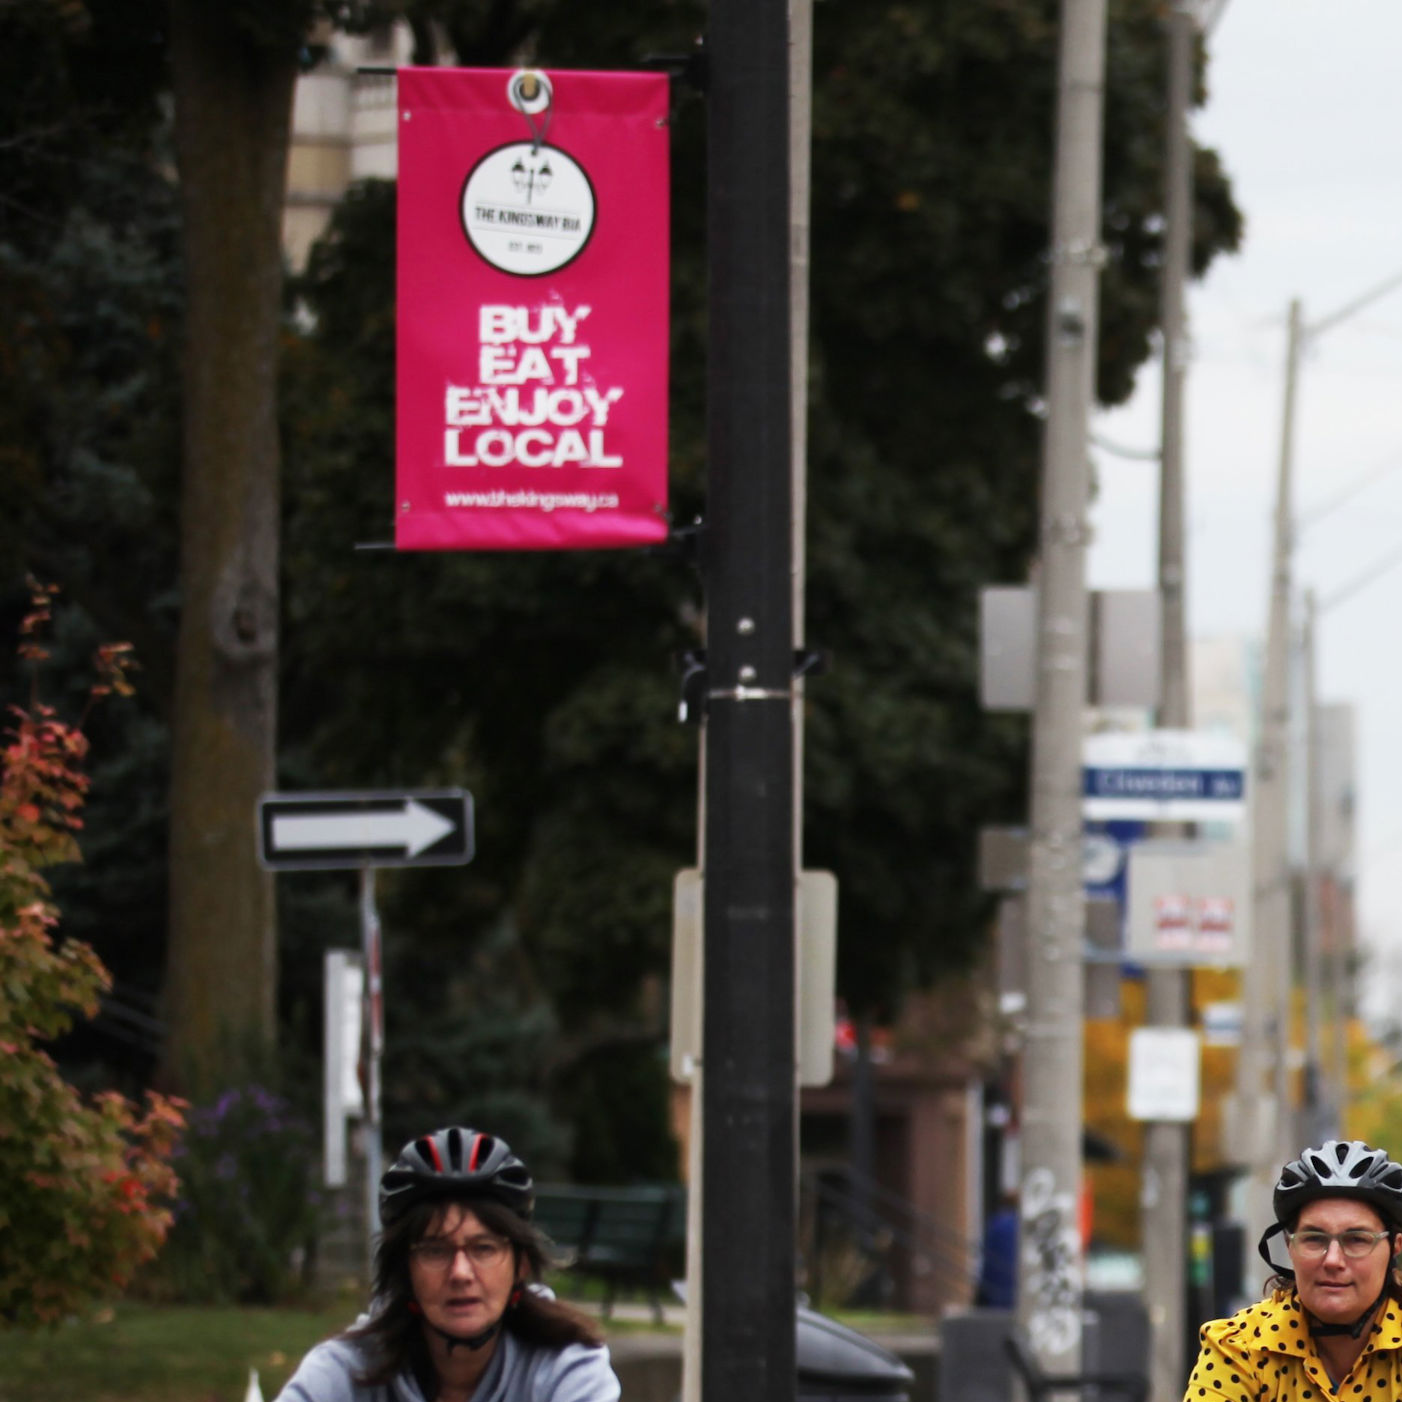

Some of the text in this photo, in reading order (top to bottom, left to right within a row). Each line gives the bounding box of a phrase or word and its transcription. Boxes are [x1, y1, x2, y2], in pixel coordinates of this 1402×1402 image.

[476, 206, 495, 222] THE
[499, 210, 558, 228] KINGSWAY
[479, 304, 592, 344] BUY
[479, 345, 592, 385] EAT
[445, 386, 624, 426] ENJOY
[444, 428, 624, 468] LOCAL
[445, 490, 620, 512] www.thekingsway.ca
